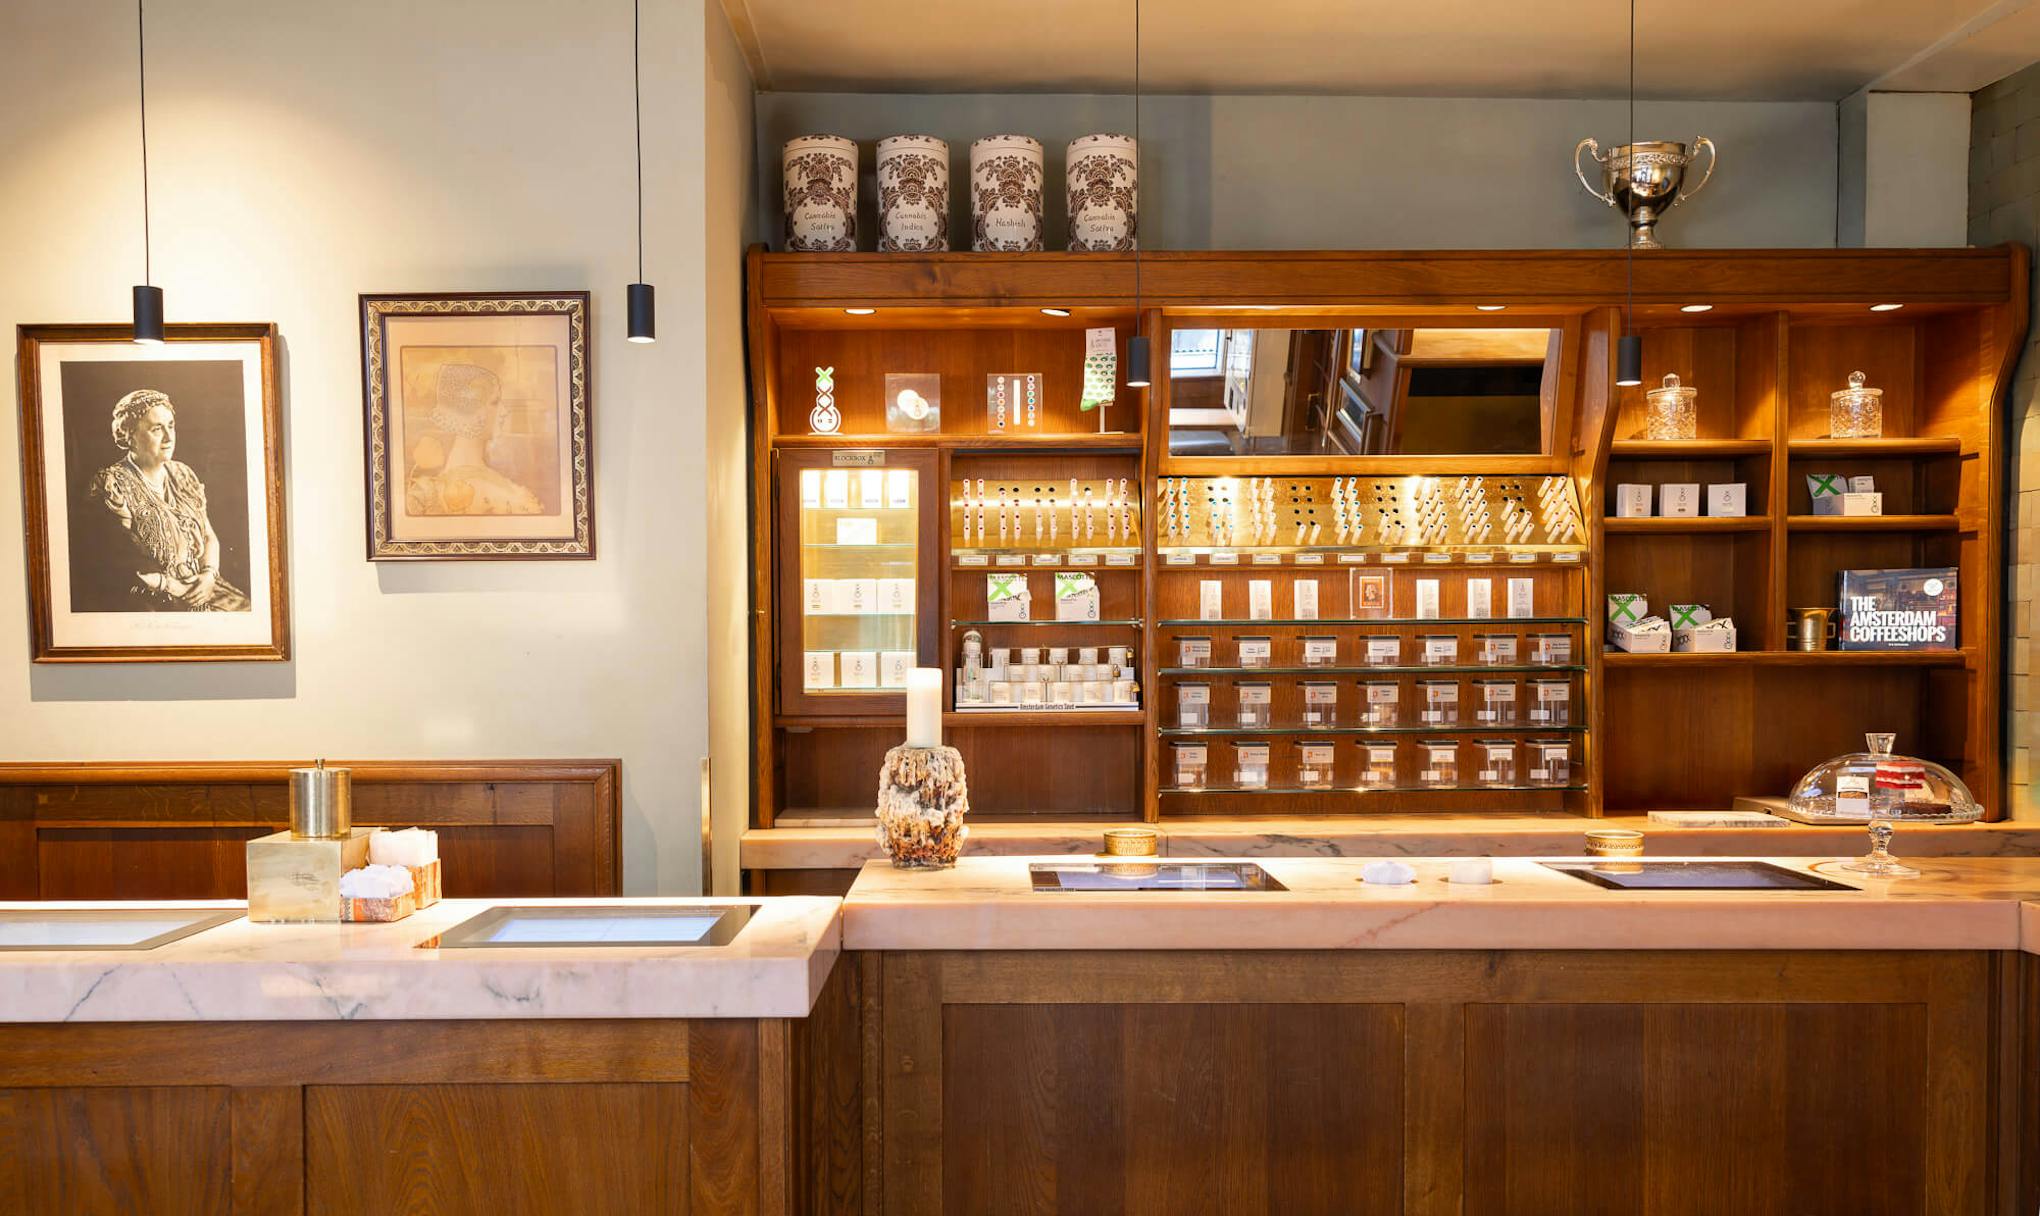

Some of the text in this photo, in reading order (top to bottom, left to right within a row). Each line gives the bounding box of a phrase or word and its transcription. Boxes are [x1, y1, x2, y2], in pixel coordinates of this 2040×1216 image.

[1850, 596, 1876, 611] THE
[1850, 611, 1936, 626] AMSTERDAM
[1850, 626, 1946, 642] COFFEESHOPS
